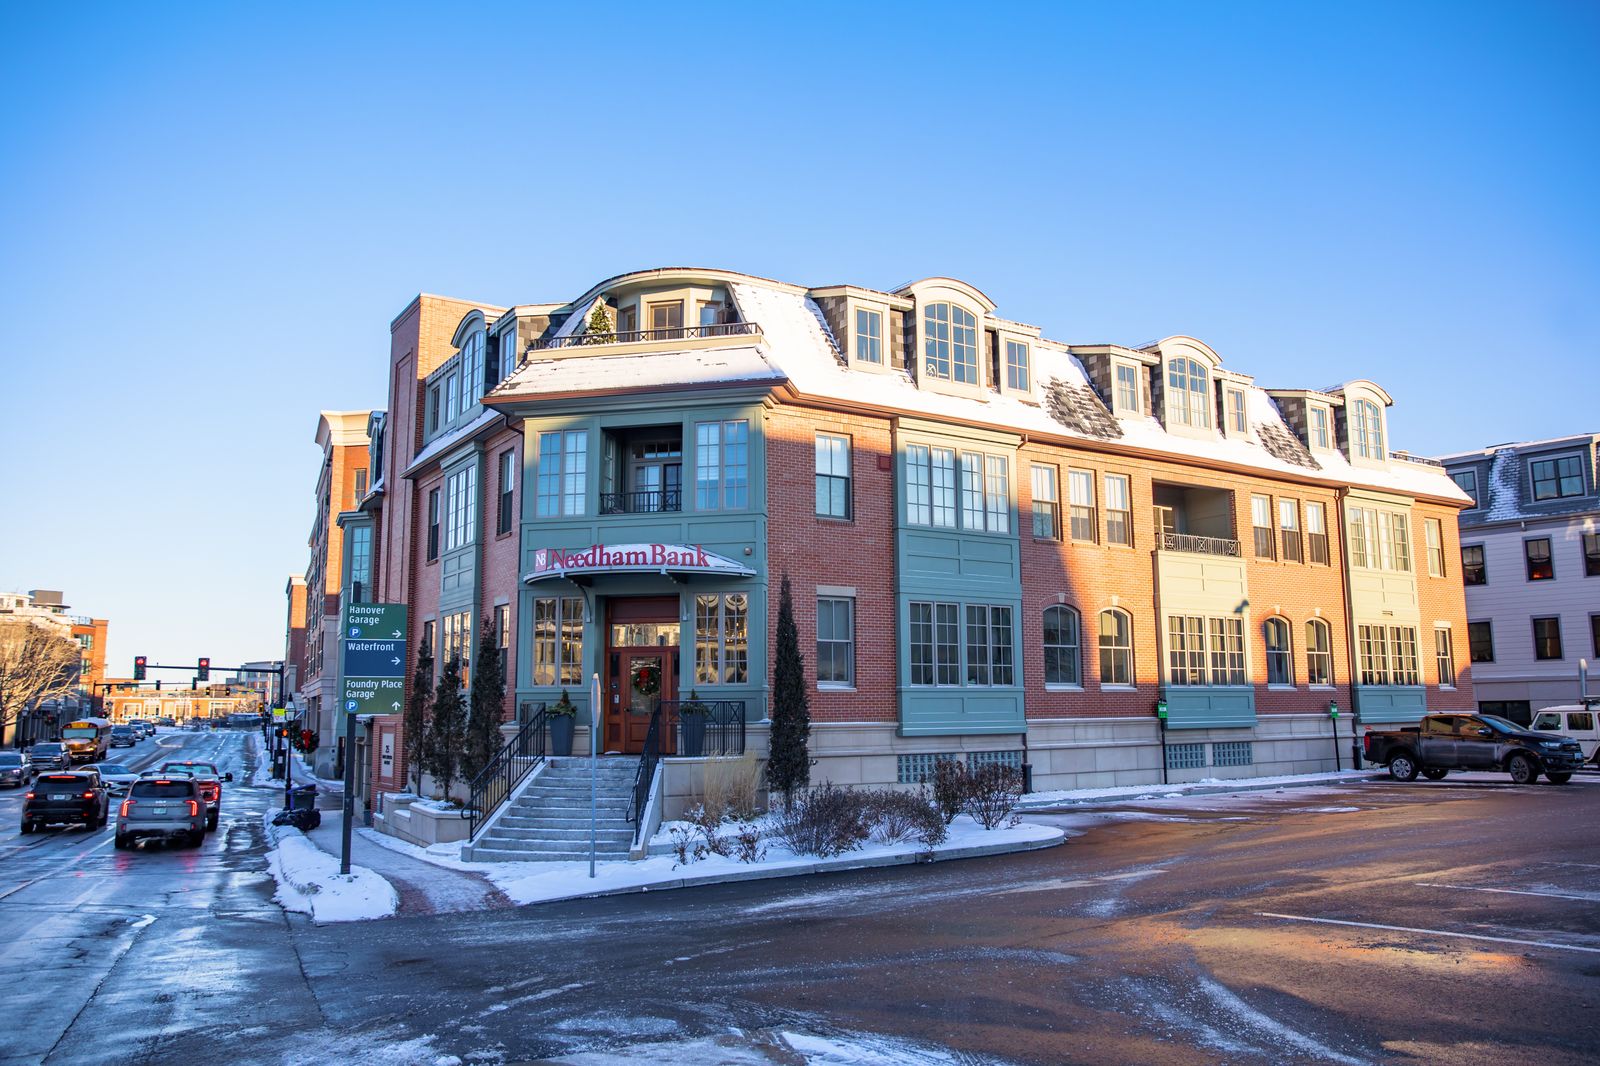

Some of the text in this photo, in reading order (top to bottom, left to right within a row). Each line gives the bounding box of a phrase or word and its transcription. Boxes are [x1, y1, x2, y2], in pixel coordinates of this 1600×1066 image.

[551, 544, 710, 570] Needham Bank
[349, 605, 385, 615] Hanover
[349, 616, 380, 626] Garage
[347, 642, 394, 651] Waterfront
[346, 680, 403, 690] Foundry Place
[346, 690, 375, 700] Garage
